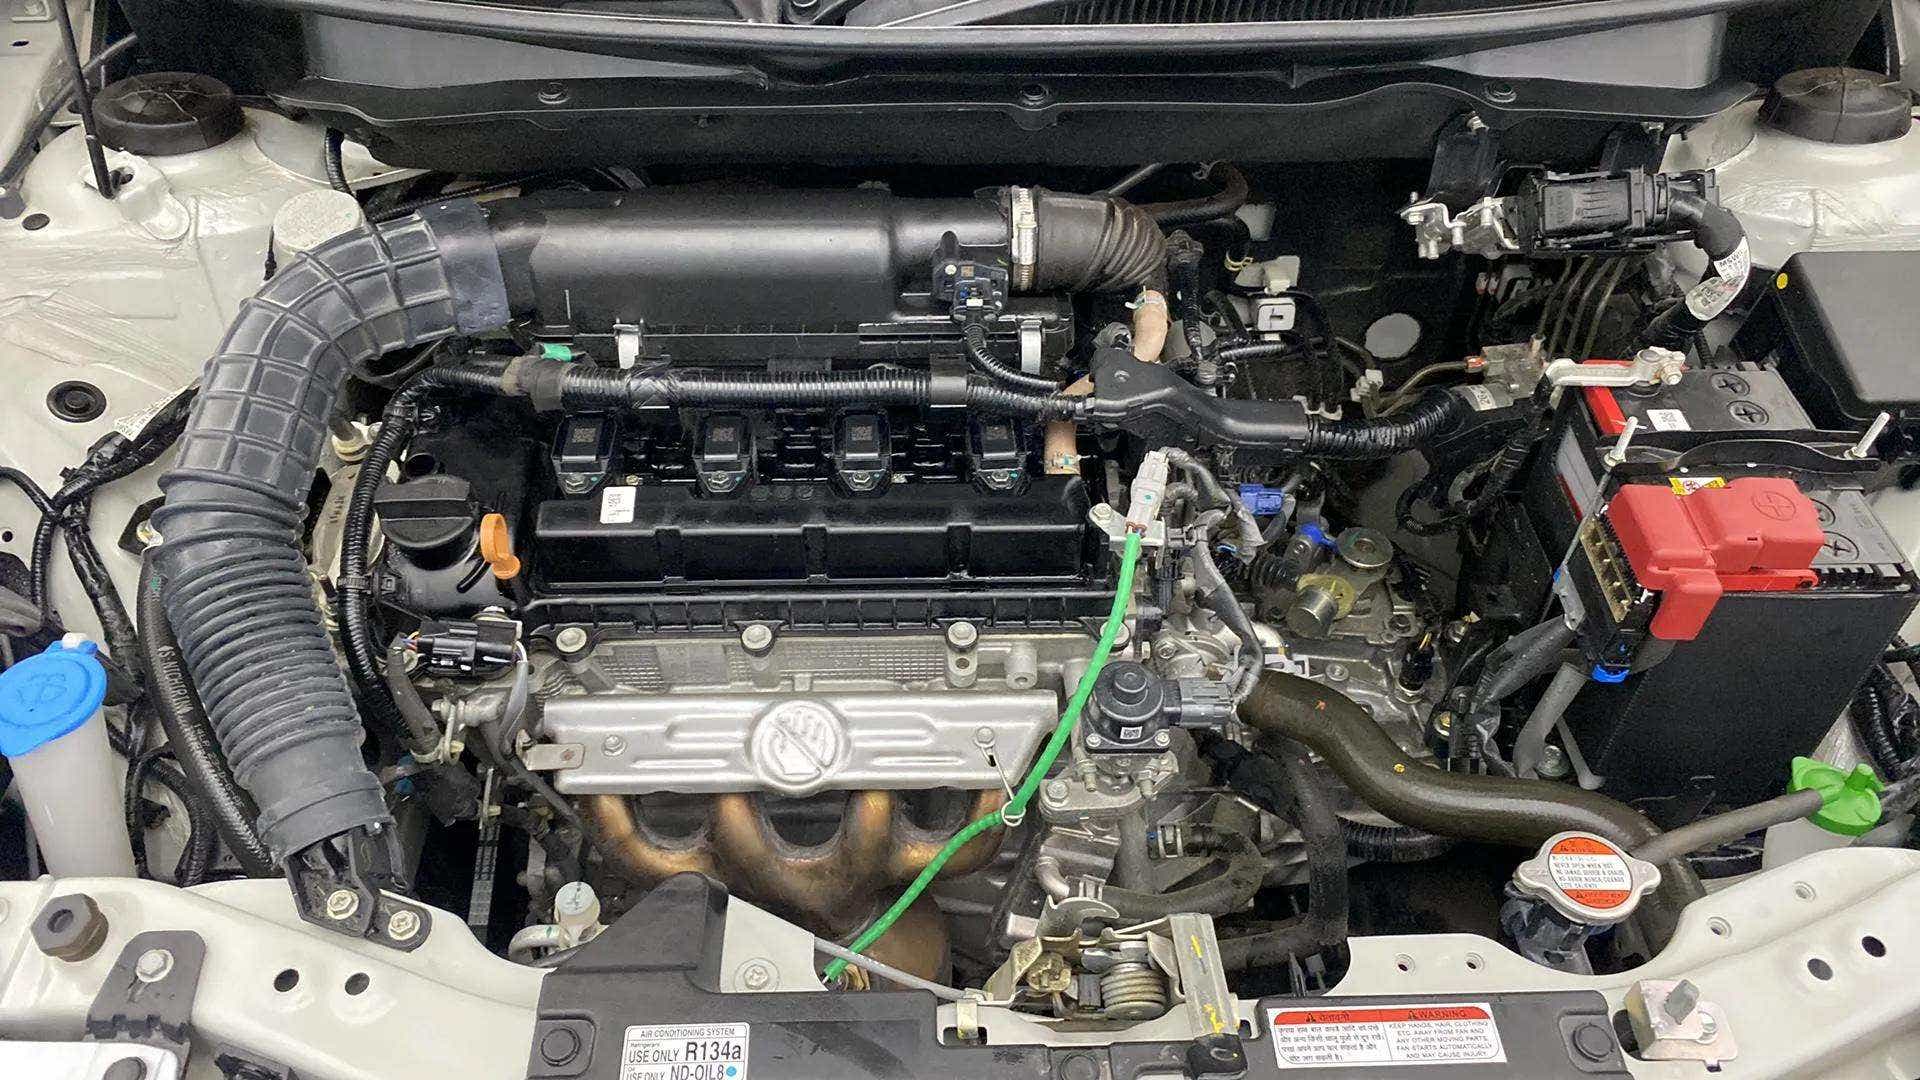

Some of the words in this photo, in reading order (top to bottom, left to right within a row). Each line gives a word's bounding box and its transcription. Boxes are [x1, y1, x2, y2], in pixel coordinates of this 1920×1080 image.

[1419, 1010, 1466, 1018] WARNING
[641, 1030, 653, 1038] AIR
[655, 1028, 705, 1037] CONDITIONING
[707, 1028, 735, 1036] SYSTEM
[629, 1050, 649, 1063] USE
[653, 1049, 679, 1062] ONLY
[686, 1041, 741, 1061] R134a
[643, 1072, 665, 1080] ONLY
[671, 1065, 724, 1080] ND-OIL8
